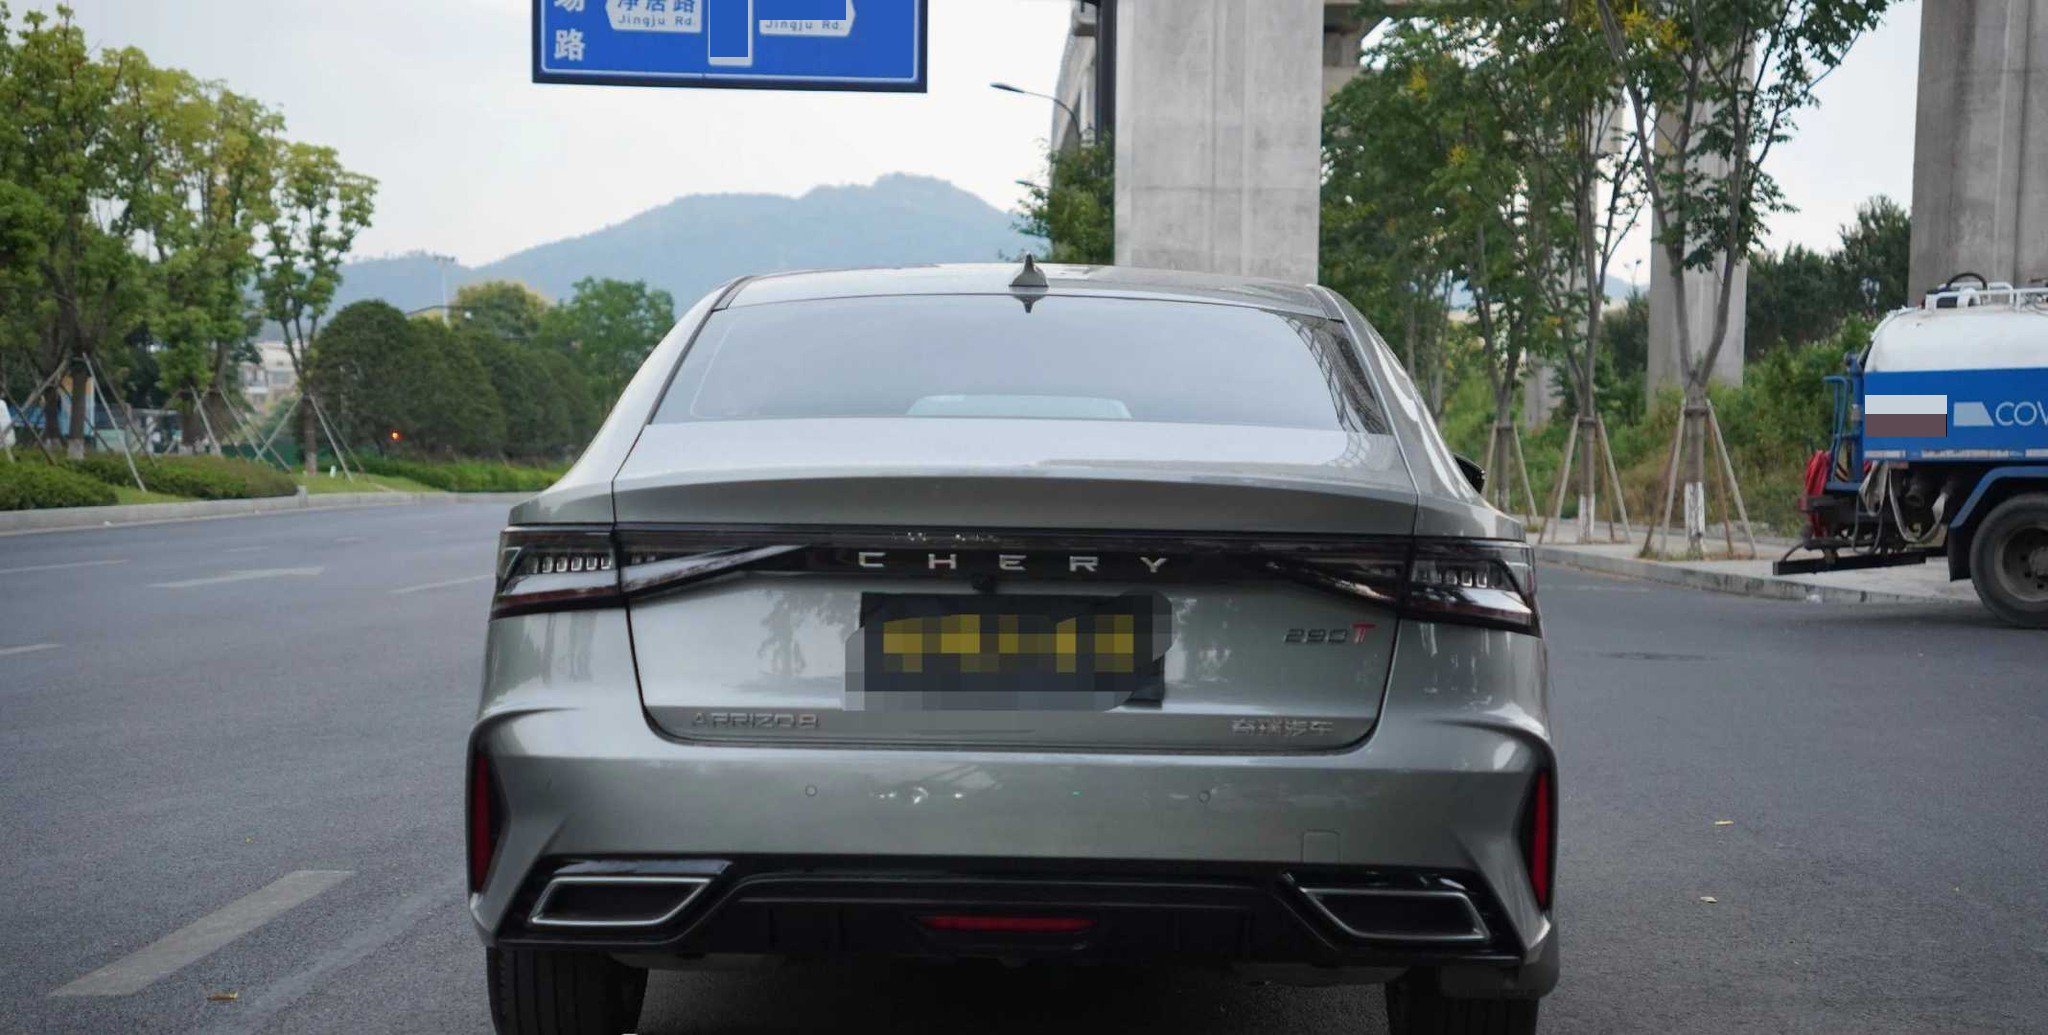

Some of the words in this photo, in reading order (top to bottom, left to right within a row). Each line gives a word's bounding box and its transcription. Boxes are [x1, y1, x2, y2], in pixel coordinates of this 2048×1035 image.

[617, 15, 666, 28] Jingju
[765, 20, 813, 31] Jingju
[858, 551, 1167, 573] CHERY
[1283, 622, 1377, 644] 290T
